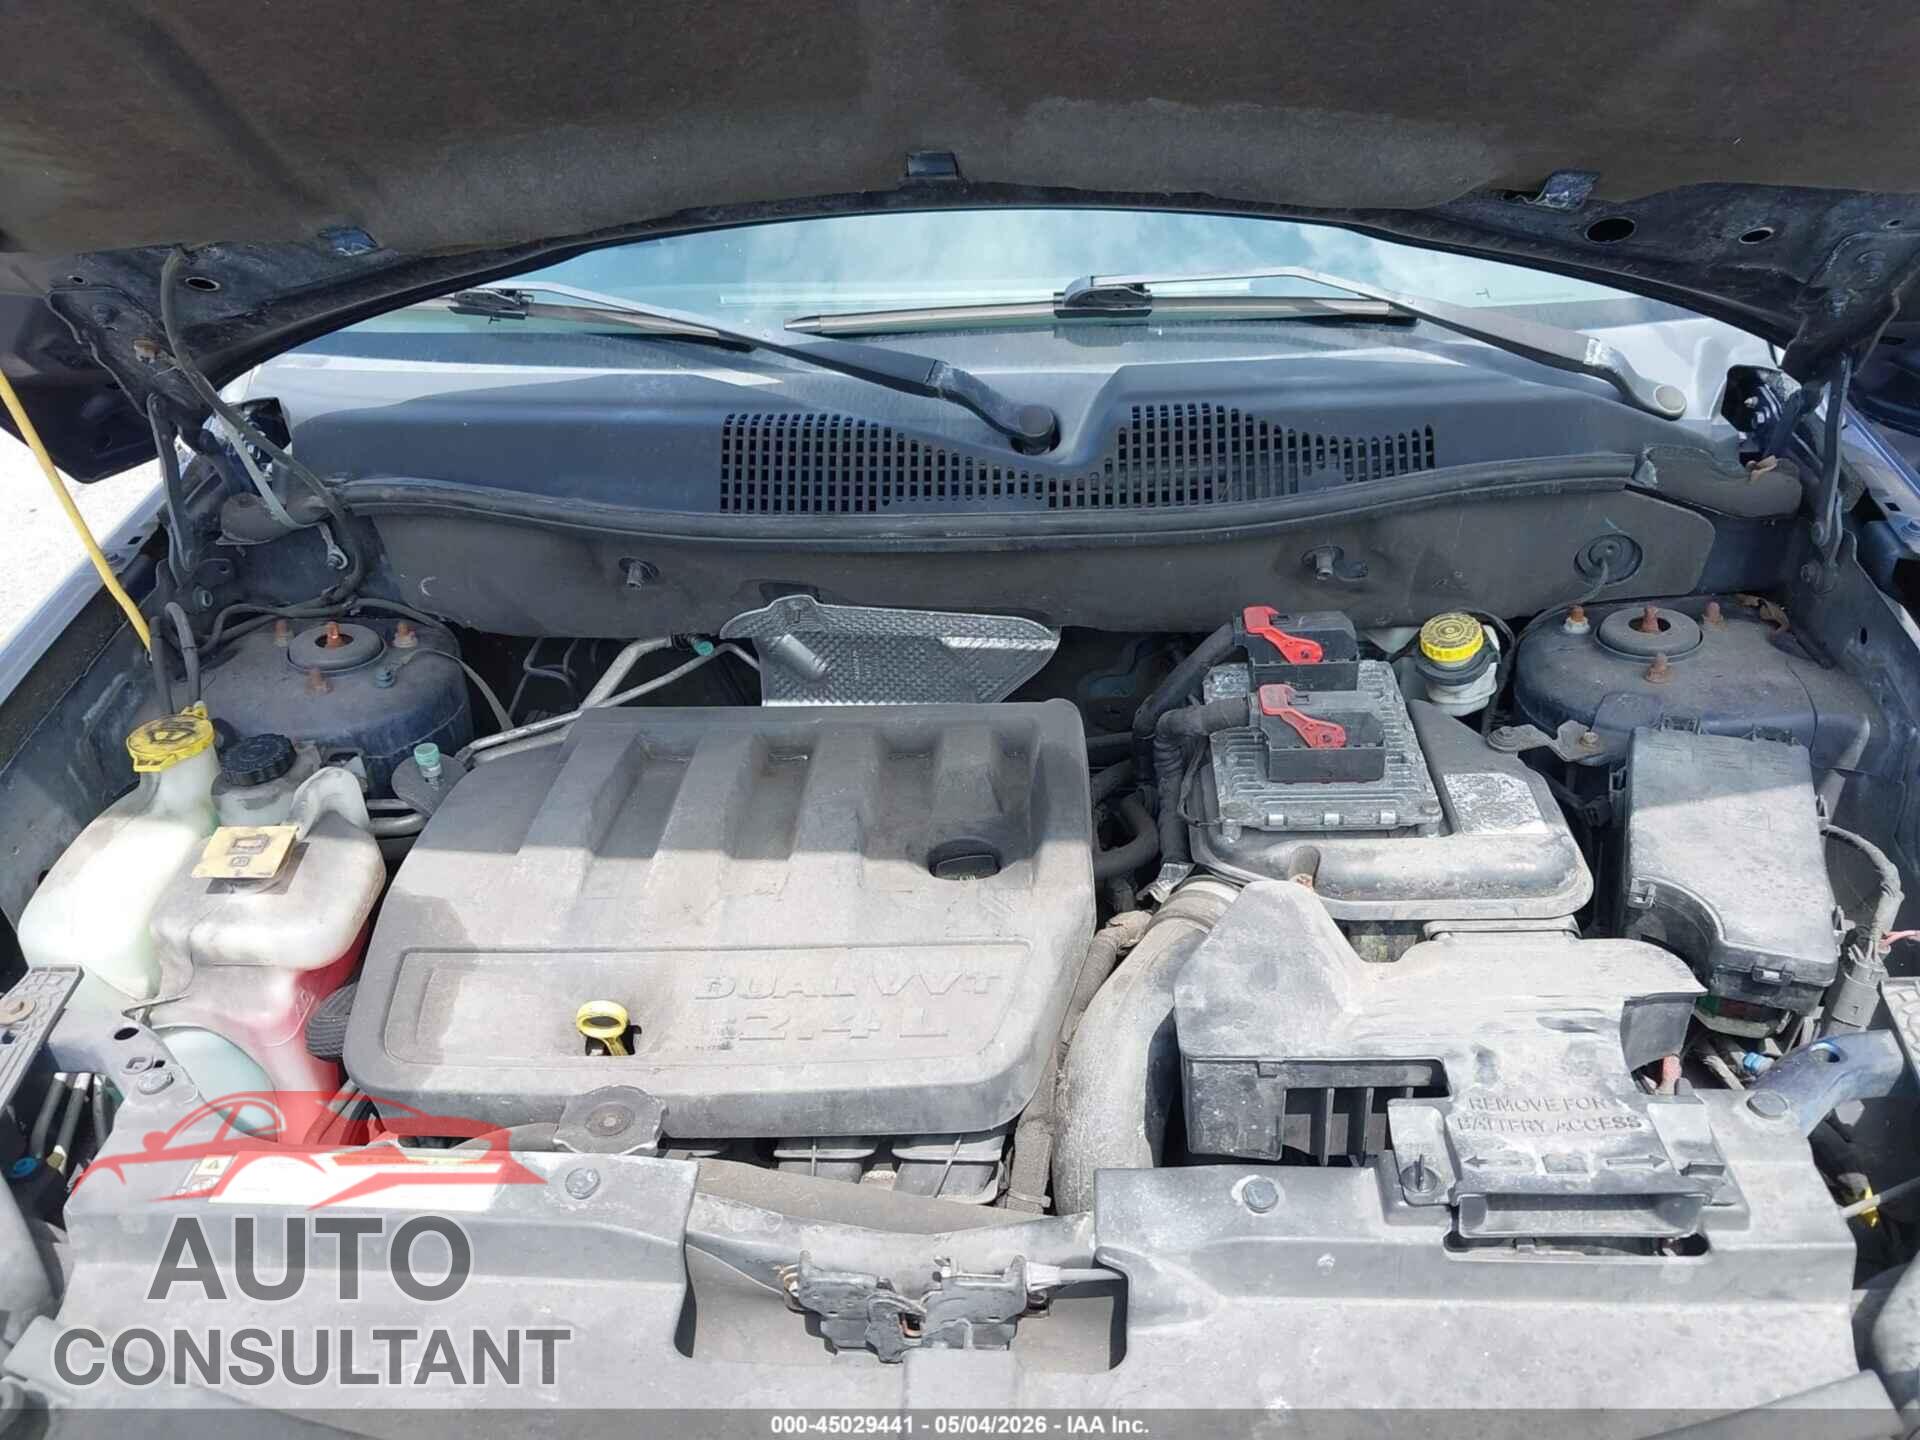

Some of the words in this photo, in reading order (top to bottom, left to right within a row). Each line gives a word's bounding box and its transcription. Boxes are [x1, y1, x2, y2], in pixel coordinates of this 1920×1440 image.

[692, 975, 857, 1001] DUAL
[868, 972, 1004, 998] VVT
[736, 1009, 950, 1042] 2.4L
[1467, 1096, 1558, 1113] REMOVE
[1563, 1095, 1607, 1112] FOR
[1456, 1116, 1546, 1133] BATTERY
[1555, 1115, 1643, 1133] ACCESS
